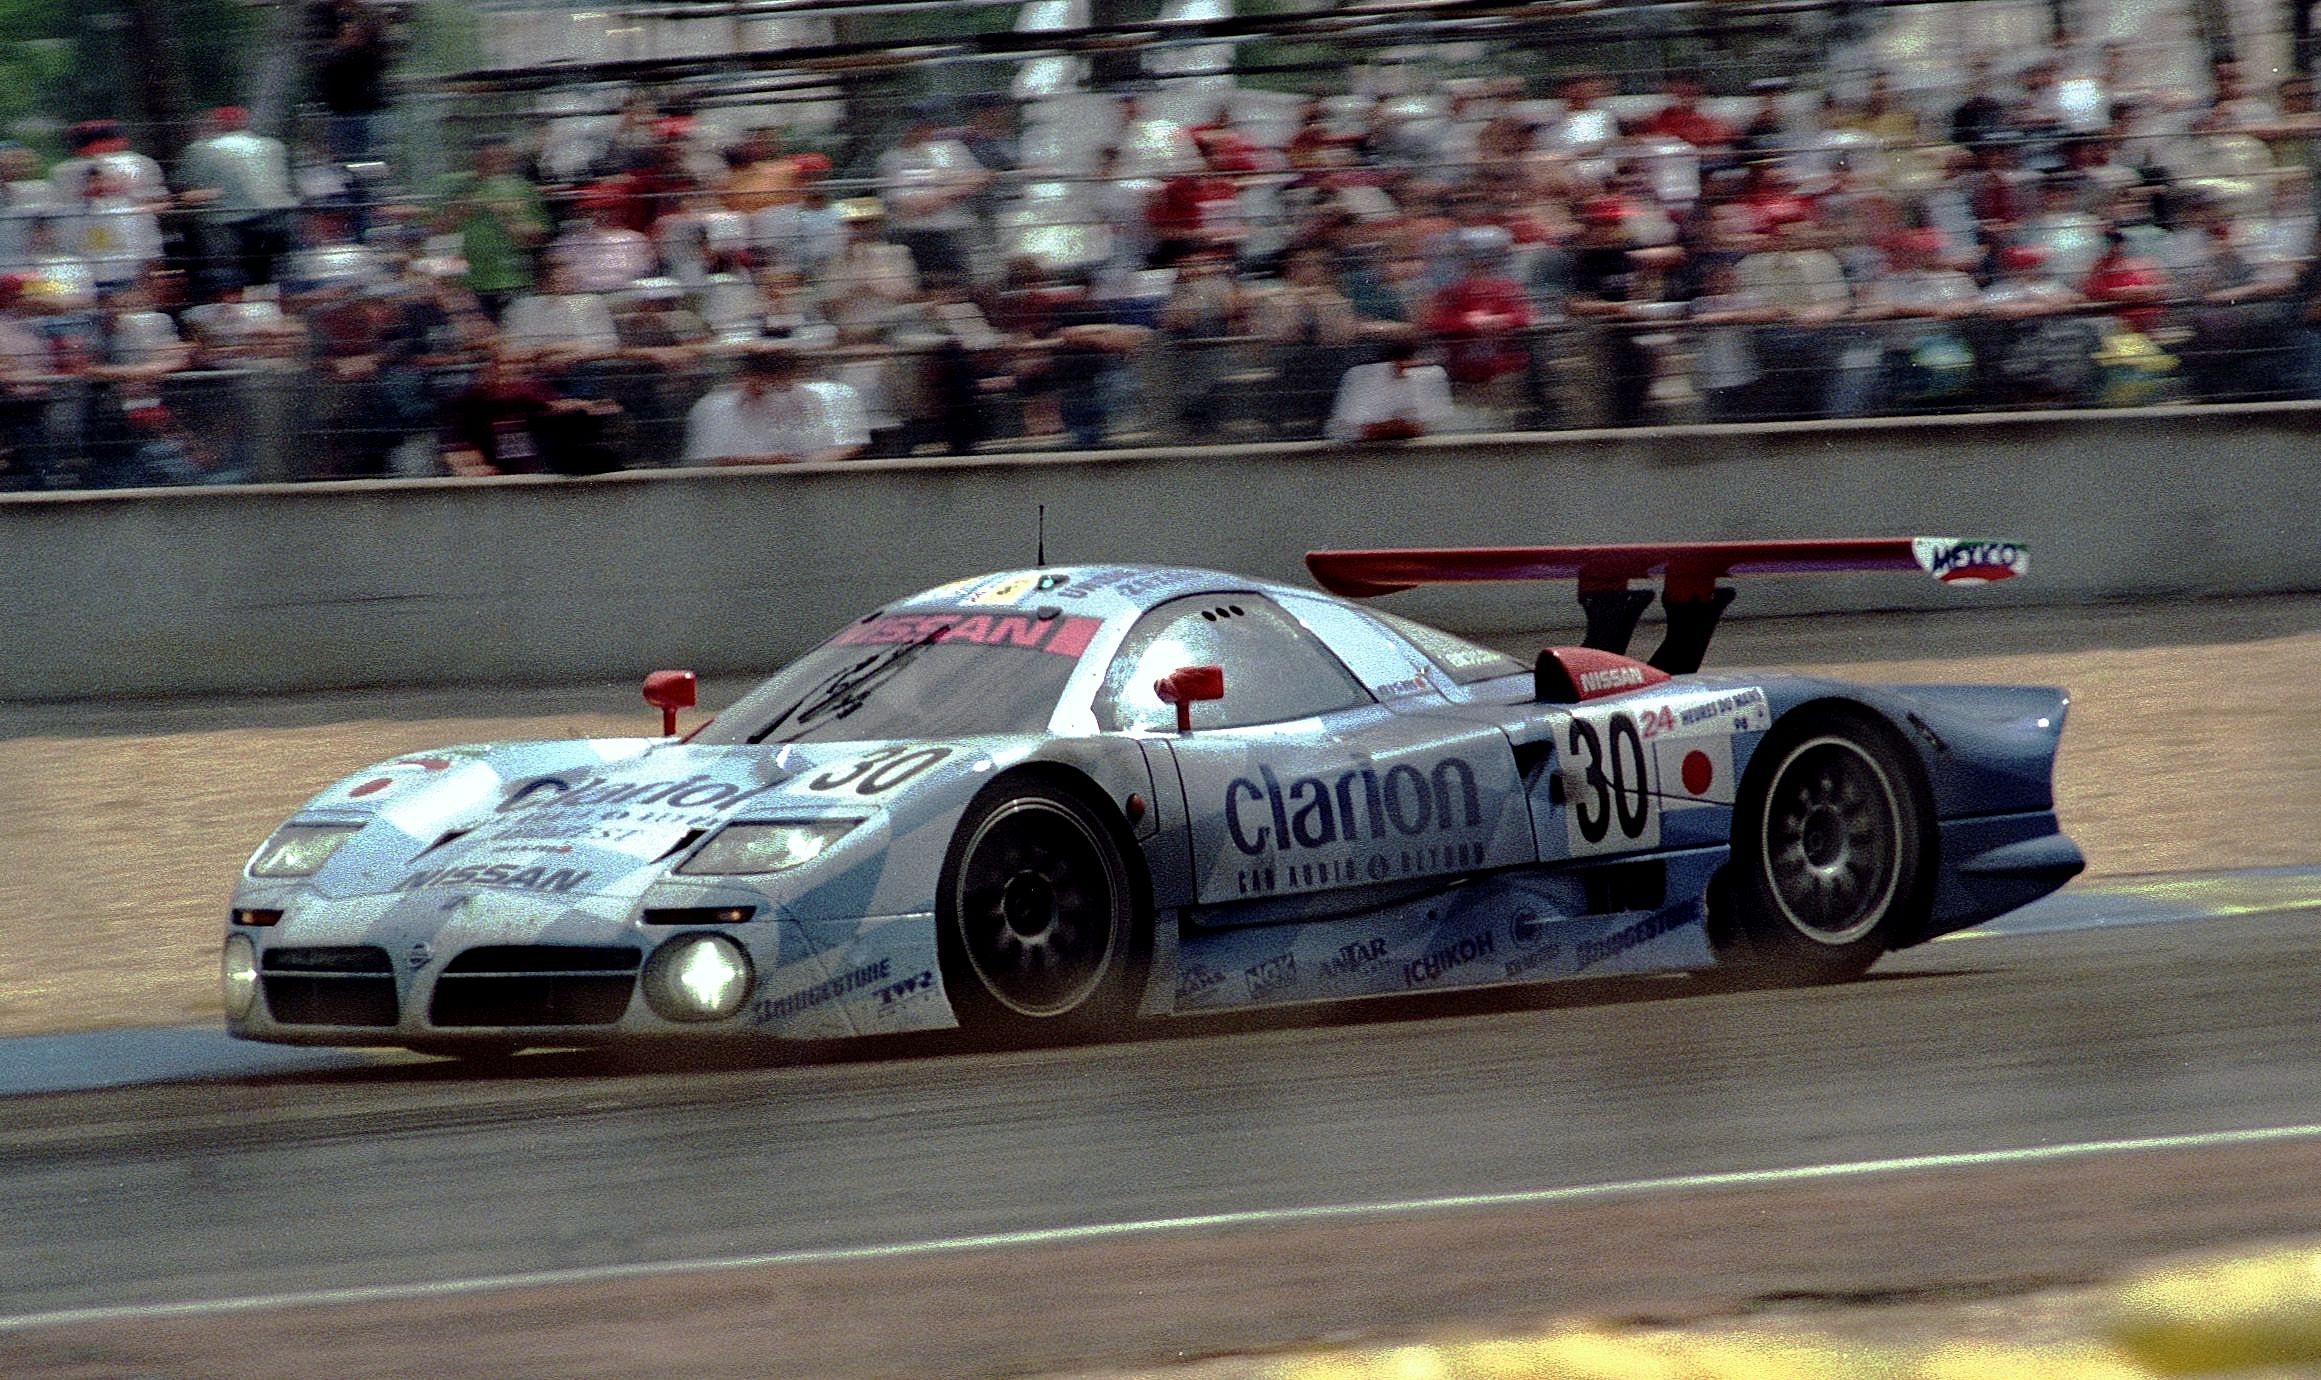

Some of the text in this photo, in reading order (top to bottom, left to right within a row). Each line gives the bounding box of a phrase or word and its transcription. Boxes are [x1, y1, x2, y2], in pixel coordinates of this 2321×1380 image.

[1933, 543, 2018, 572] MEXICO
[1581, 667, 1644, 693] NISSAN
[1640, 705, 1676, 738] 24
[809, 746, 953, 795] 30
[1569, 712, 1649, 844] 30
[388, 863, 592, 893] NISSAN
[1403, 931, 1495, 987] ICHIKOH
